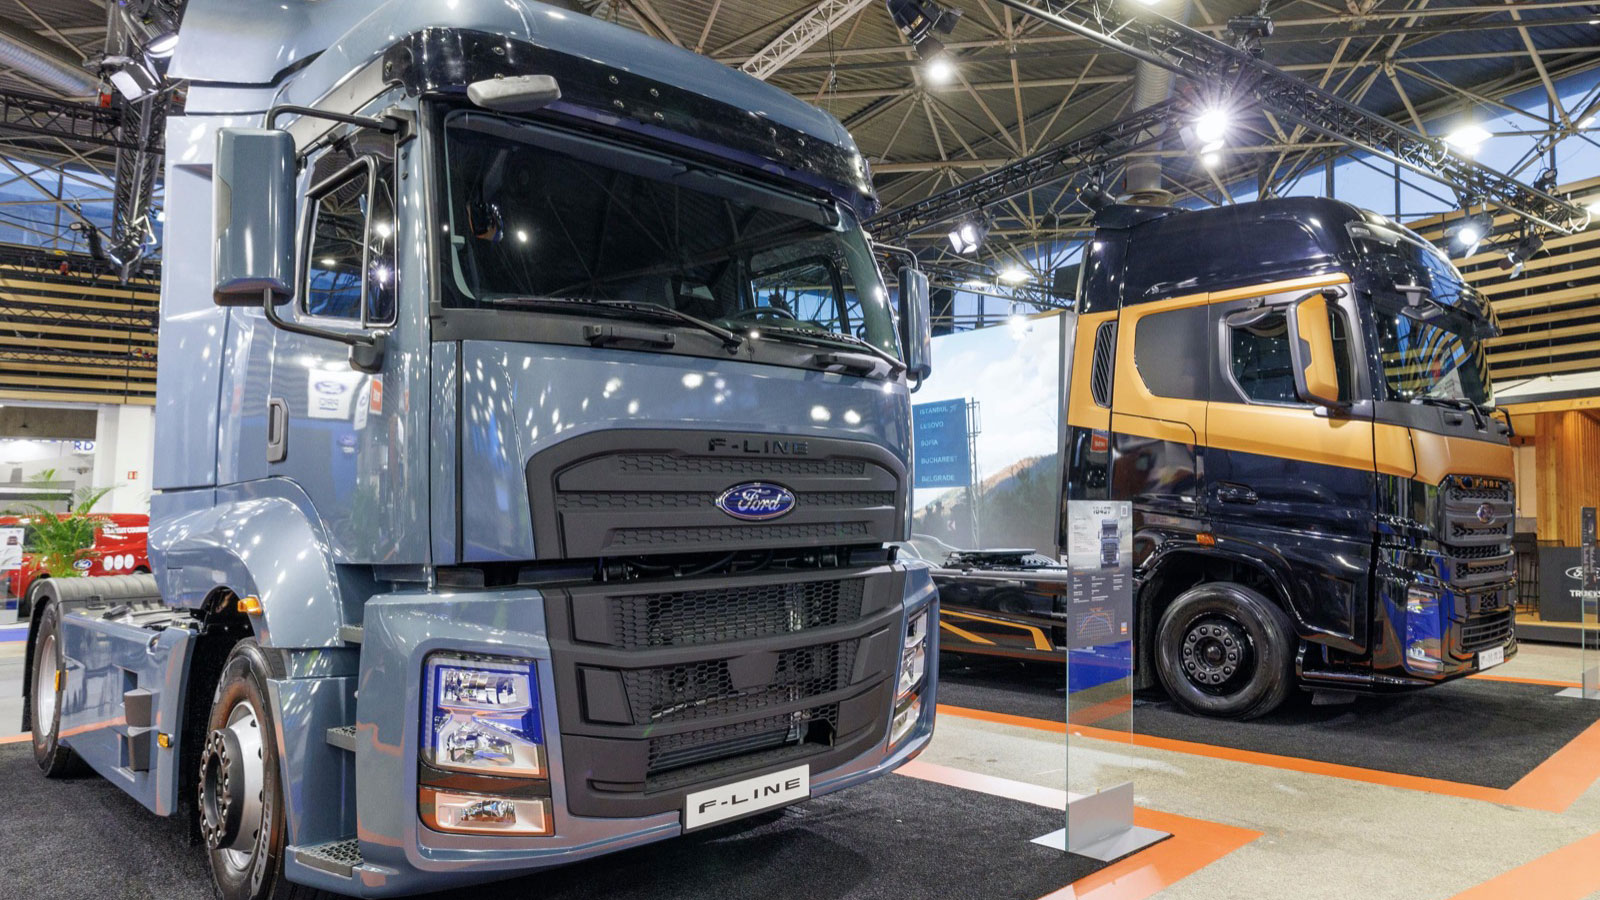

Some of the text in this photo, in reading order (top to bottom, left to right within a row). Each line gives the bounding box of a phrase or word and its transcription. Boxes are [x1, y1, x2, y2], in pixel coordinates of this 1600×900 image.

[919, 406, 948, 415] ISTANBUL
[708, 438, 808, 455] F-LINE
[921, 455, 958, 465] BUCHAREST
[737, 488, 782, 512] Ford
[698, 777, 801, 814] F-LINE
